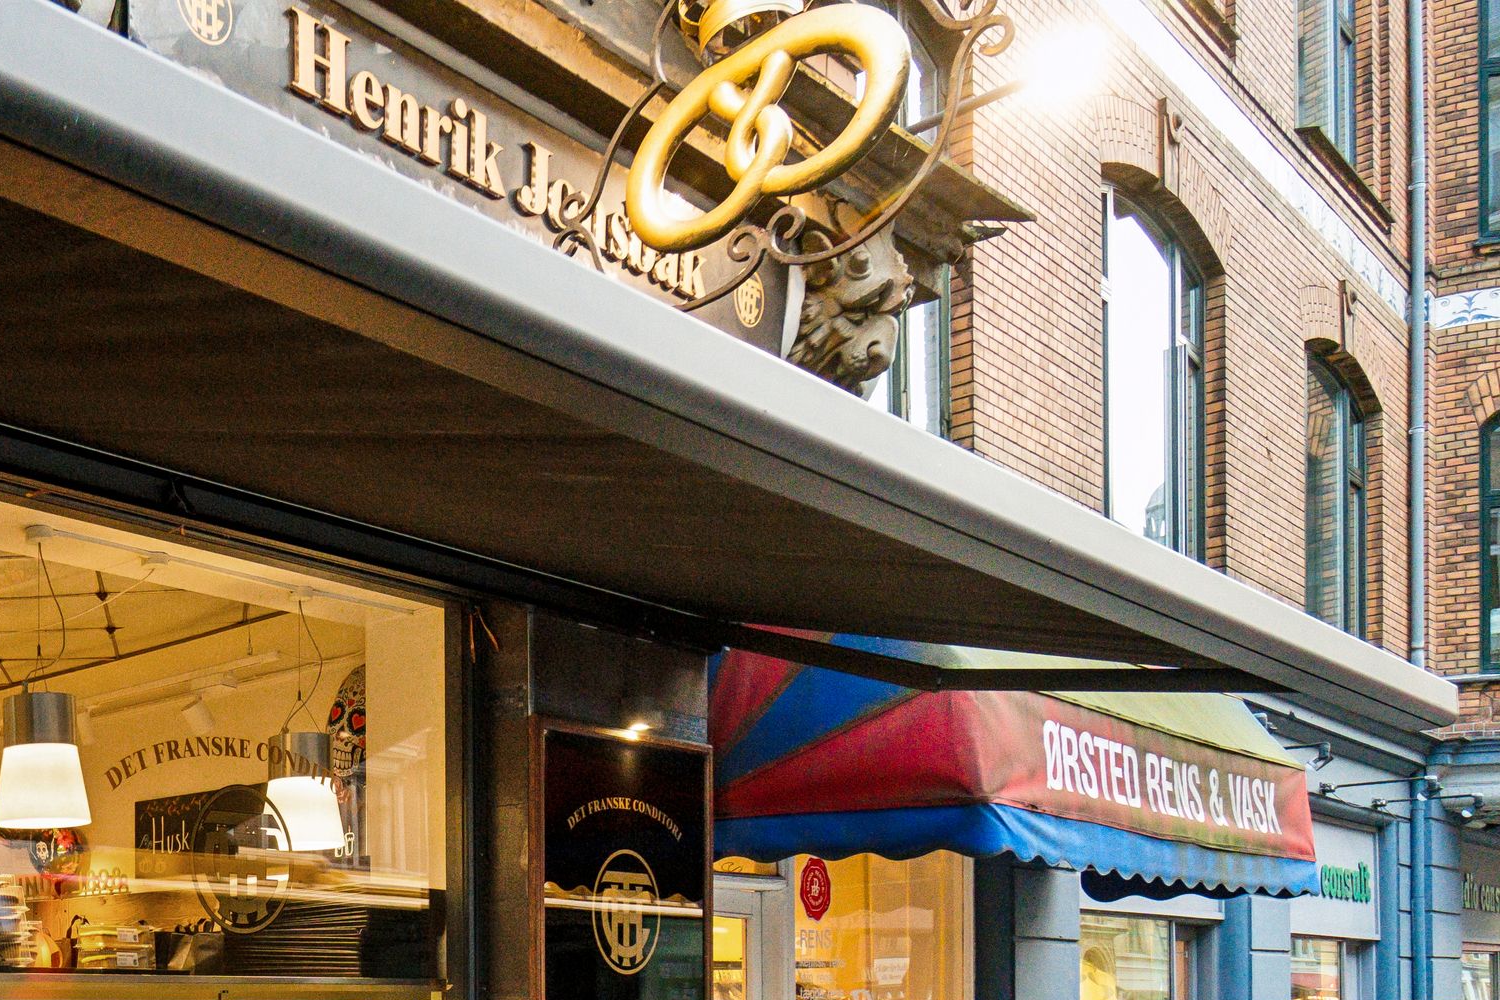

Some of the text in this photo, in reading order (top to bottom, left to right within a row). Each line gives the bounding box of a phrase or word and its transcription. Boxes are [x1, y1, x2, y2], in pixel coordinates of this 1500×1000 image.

[288, 6, 506, 199] Henrik
[104, 749, 147, 791] DET
[152, 736, 251, 766] FRANSKE
[1043, 719, 1283, 835] ØRSTED RENS & VASK
[152, 815, 190, 855] Husk
[566, 797, 683, 843] DET FRANSKE CONDITORI
[1321, 861, 1372, 905] consult
